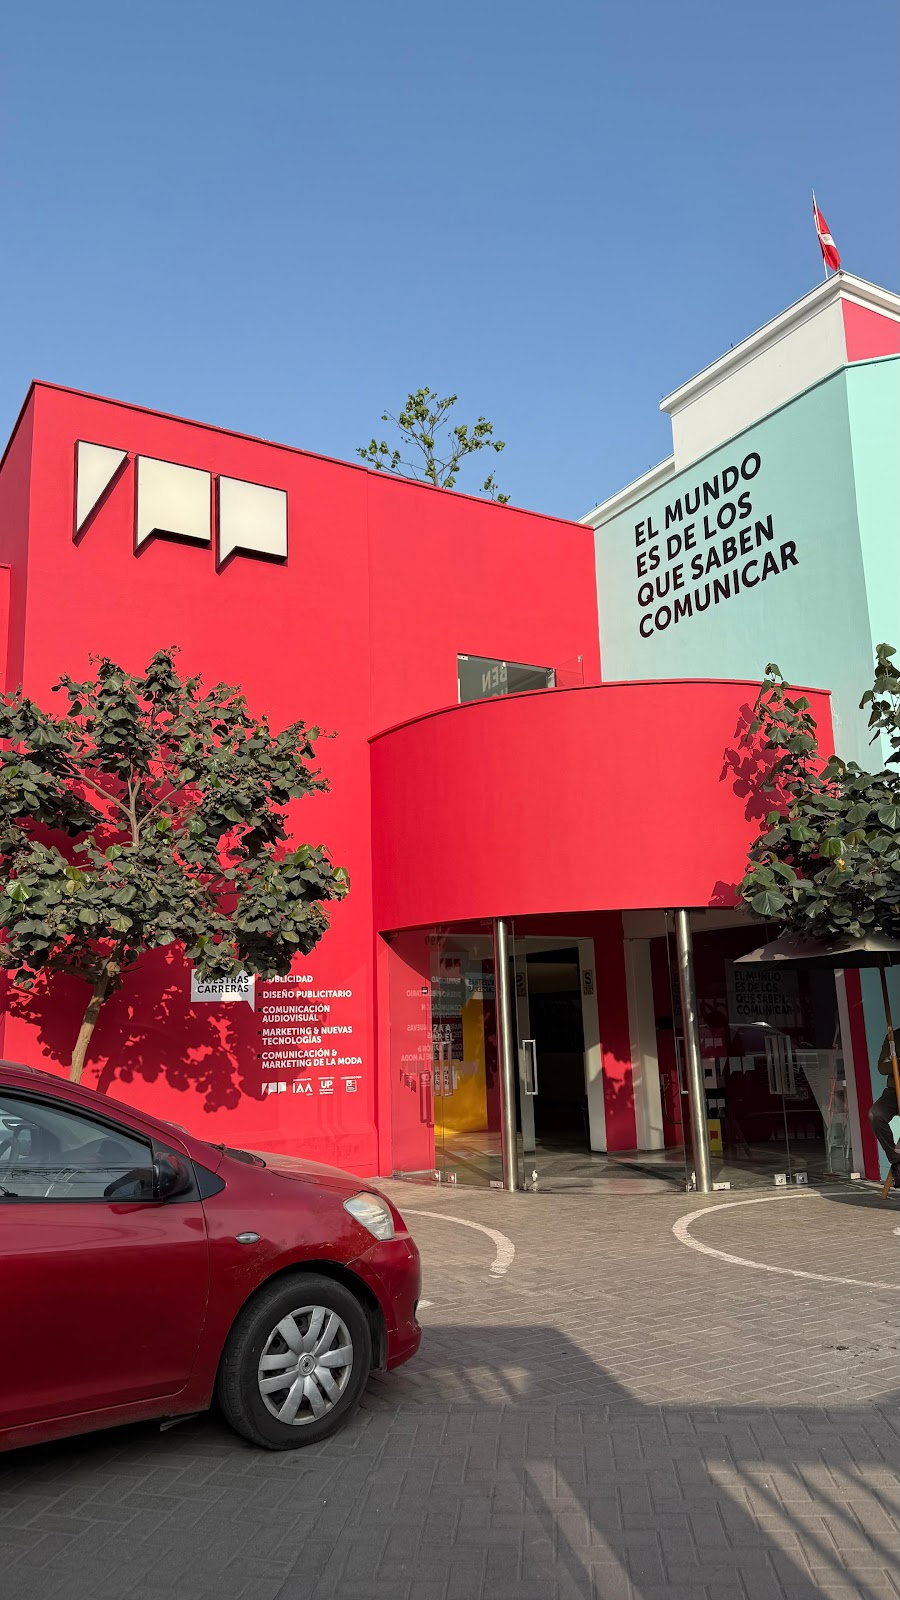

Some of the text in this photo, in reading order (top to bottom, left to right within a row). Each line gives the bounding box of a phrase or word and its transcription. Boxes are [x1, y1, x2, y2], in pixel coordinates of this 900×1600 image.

[634, 452, 761, 547] EL MUNDO
[636, 491, 753, 578] ES DE LOS
[637, 514, 774, 607] QUE SABEN
[639, 540, 799, 638] COMUNICAR
[734, 971, 744, 980] EL
[197, 985, 249, 993] CARRERAS
[735, 982, 778, 992] ES DE LOS
[262, 989, 352, 999] DISEÑO PUBLICITARIO
[736, 993, 755, 1004] QUE
[262, 1004, 330, 1014] COMUNICACIÓN
[737, 1005, 793, 1015] COMUNICAR
[262, 1014, 319, 1023] AUDIOVISUAL
[262, 1027, 312, 1036] MARKETING
[321, 1026, 353, 1034] NUEVAS
[262, 1035, 322, 1046] TECNOLOGÍAS
[262, 1048, 338, 1060] COMUNICACIÓN &
[262, 1059, 312, 1069] MARKETING
[338, 1057, 362, 1065] MODA
[321, 1080, 333, 1089] UP
